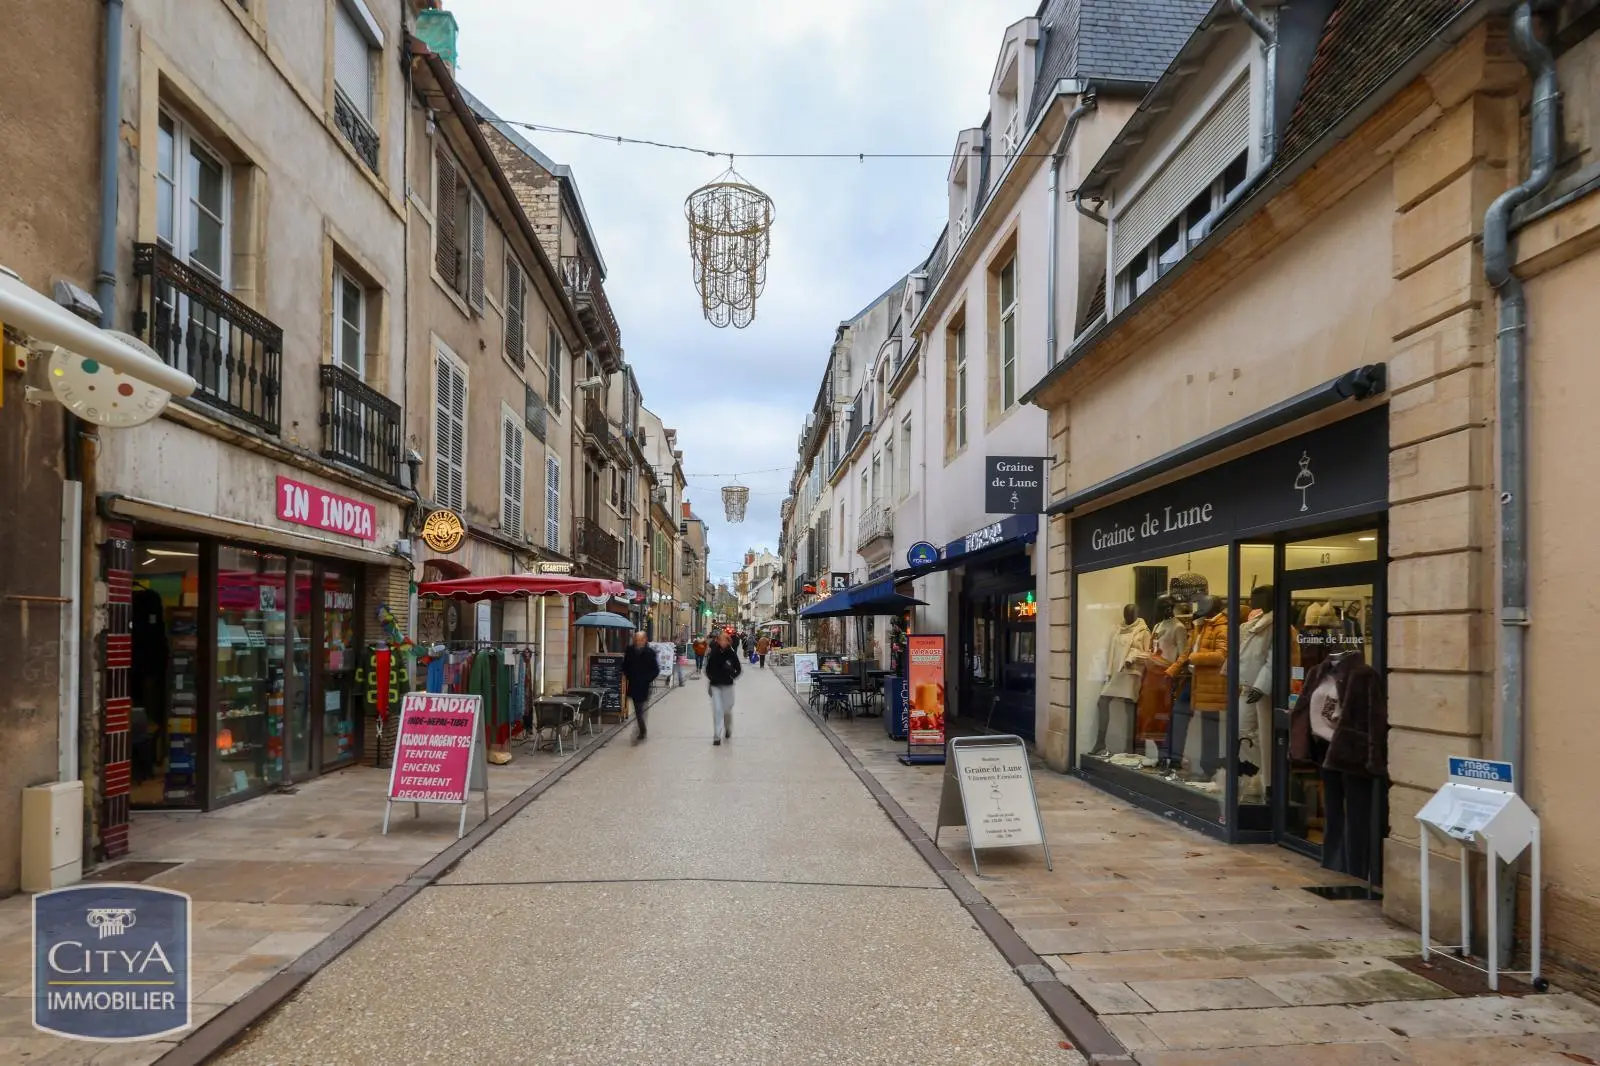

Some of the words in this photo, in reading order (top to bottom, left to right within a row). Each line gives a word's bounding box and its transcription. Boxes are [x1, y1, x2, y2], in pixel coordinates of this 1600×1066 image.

[996, 461, 1034, 472] Graine
[992, 477, 1006, 487] de
[1008, 477, 1038, 488] Lune
[283, 484, 310, 521] IN
[321, 495, 372, 537] INDIA
[1092, 523, 1135, 551] Graine
[1140, 512, 1160, 538] de
[1163, 502, 1213, 533] Lune
[115, 540, 128, 550] 62
[1319, 552, 1331, 565] 43
[541, 564, 571, 573] CIGARETTES
[834, 576, 846, 588] R
[1296, 633, 1324, 645] Graine
[1325, 633, 1337, 644] de
[1339, 633, 1364, 644] Lune
[406, 696, 427, 712] IN
[429, 697, 476, 713] INDIA
[428, 734, 457, 747] ARGENT
[457, 735, 471, 748] 925
[404, 749, 449, 760] TENTURE
[402, 762, 442, 773] ENCENS
[964, 765, 991, 774] Graine
[991, 764, 1001, 773] de
[1002, 764, 1022, 773] Lune
[400, 776, 452, 787] VETEMENT
[397, 790, 462, 801] DECORATION
